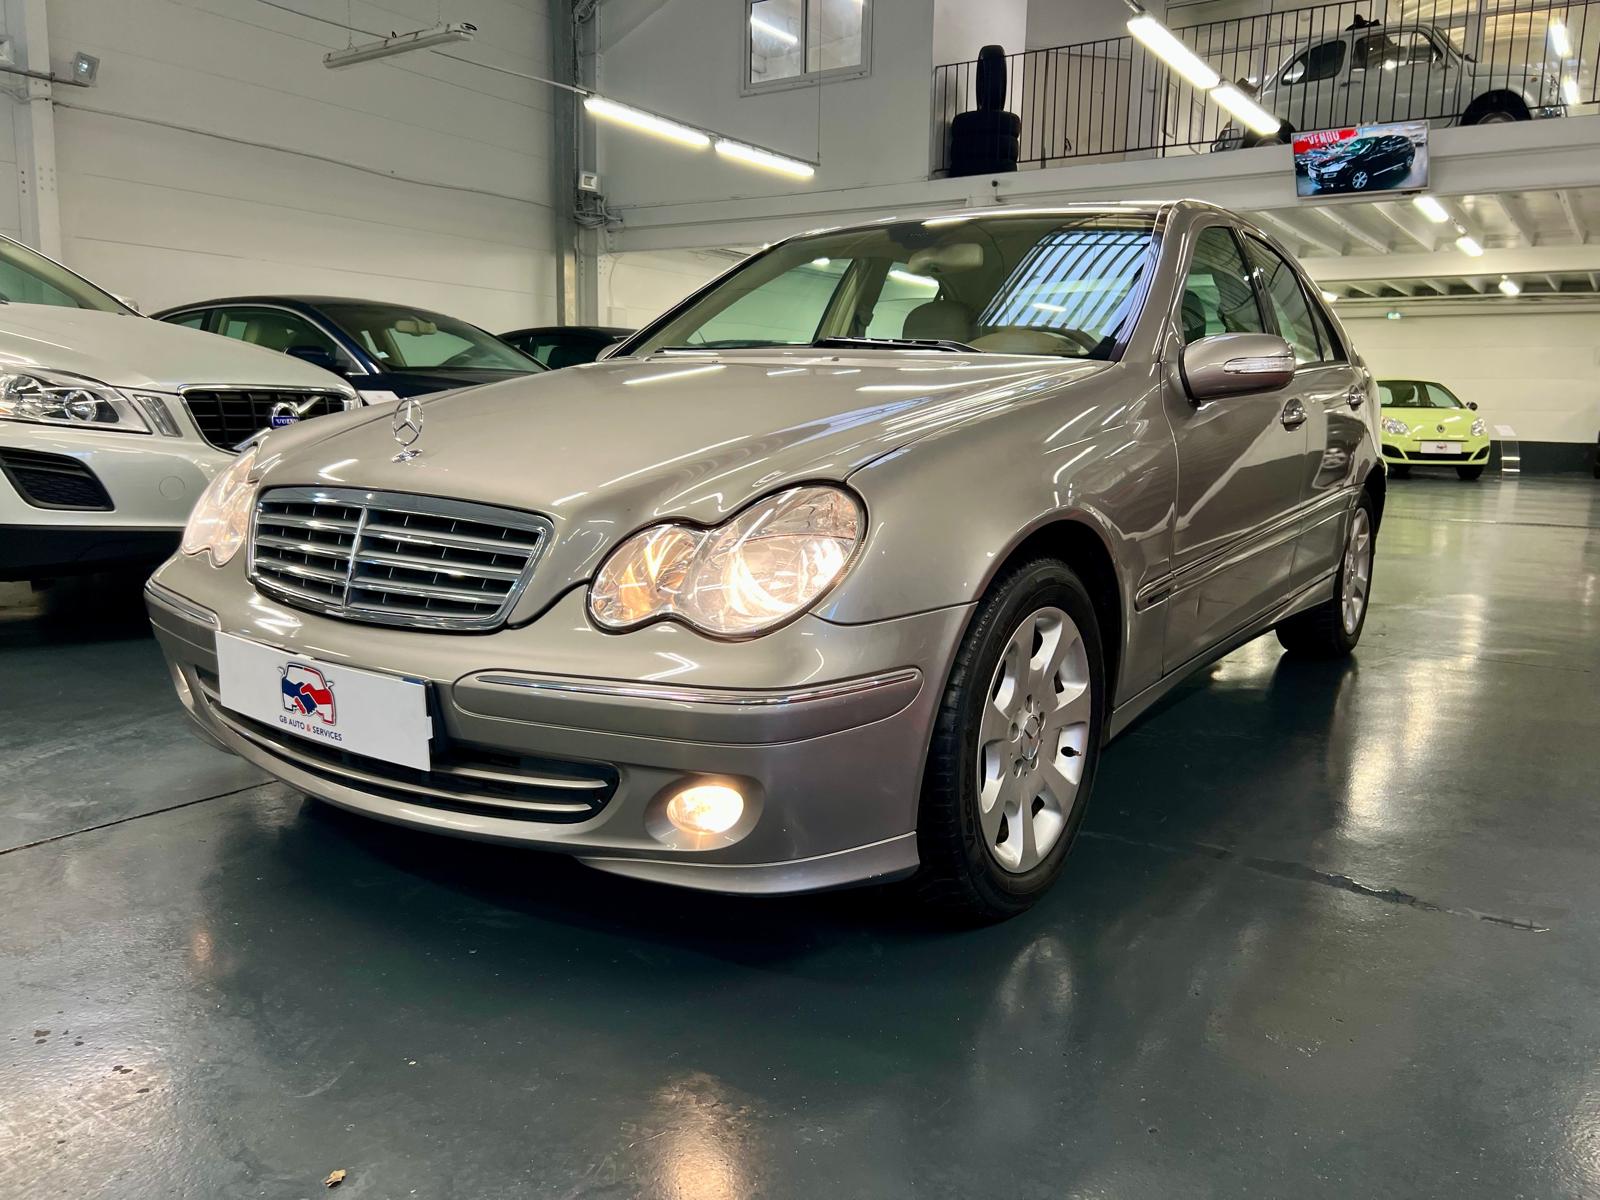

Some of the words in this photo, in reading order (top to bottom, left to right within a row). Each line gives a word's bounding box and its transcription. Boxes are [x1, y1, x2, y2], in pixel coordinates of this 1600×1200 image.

[1308, 131, 1340, 144] VENDU
[279, 715, 288, 724] GB
[289, 718, 305, 730] AUTO
[306, 724, 311, 732] &
[312, 725, 343, 742] SERVICES
